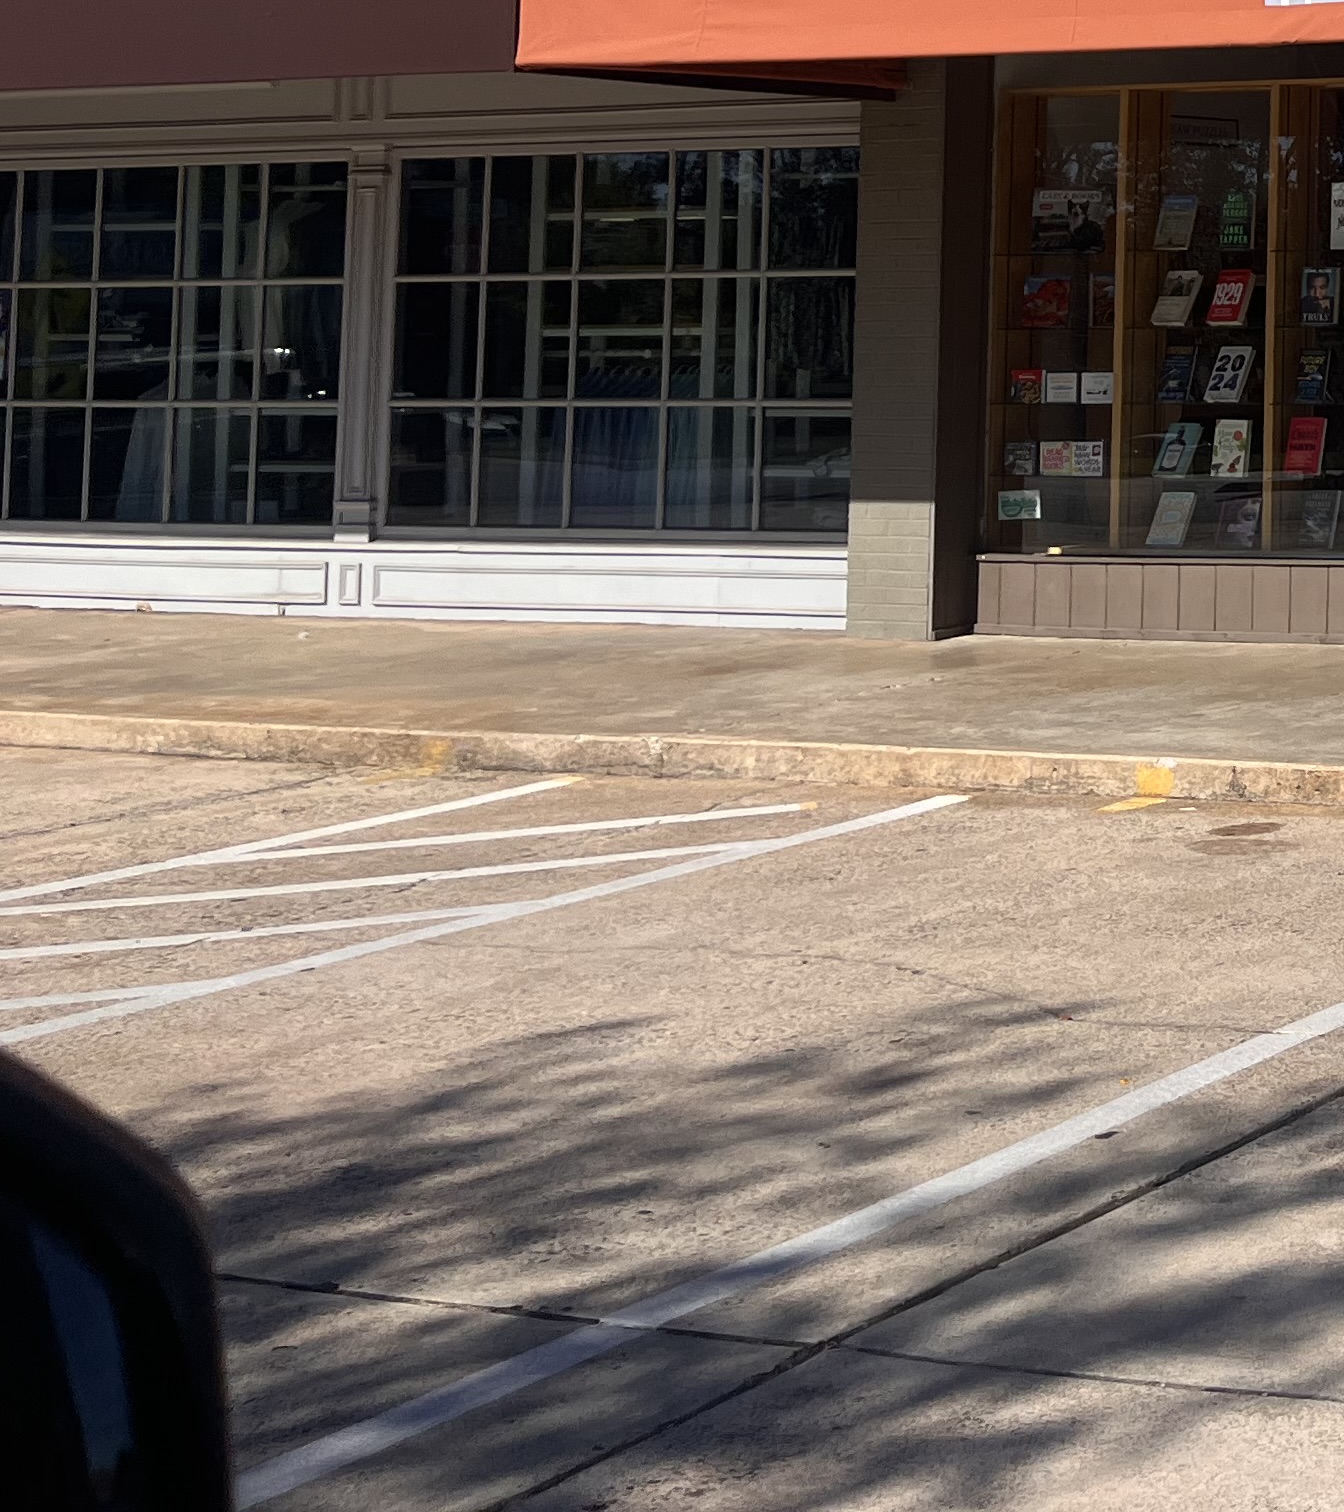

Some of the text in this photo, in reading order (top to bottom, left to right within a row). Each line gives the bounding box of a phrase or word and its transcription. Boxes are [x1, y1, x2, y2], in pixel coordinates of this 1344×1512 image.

[1219, 234, 1248, 244] TAPPER
[1213, 282, 1244, 306] 1929
[1302, 312, 1330, 322] TRULY
[1215, 354, 1246, 373] 20
[1208, 373, 1240, 392] 24
